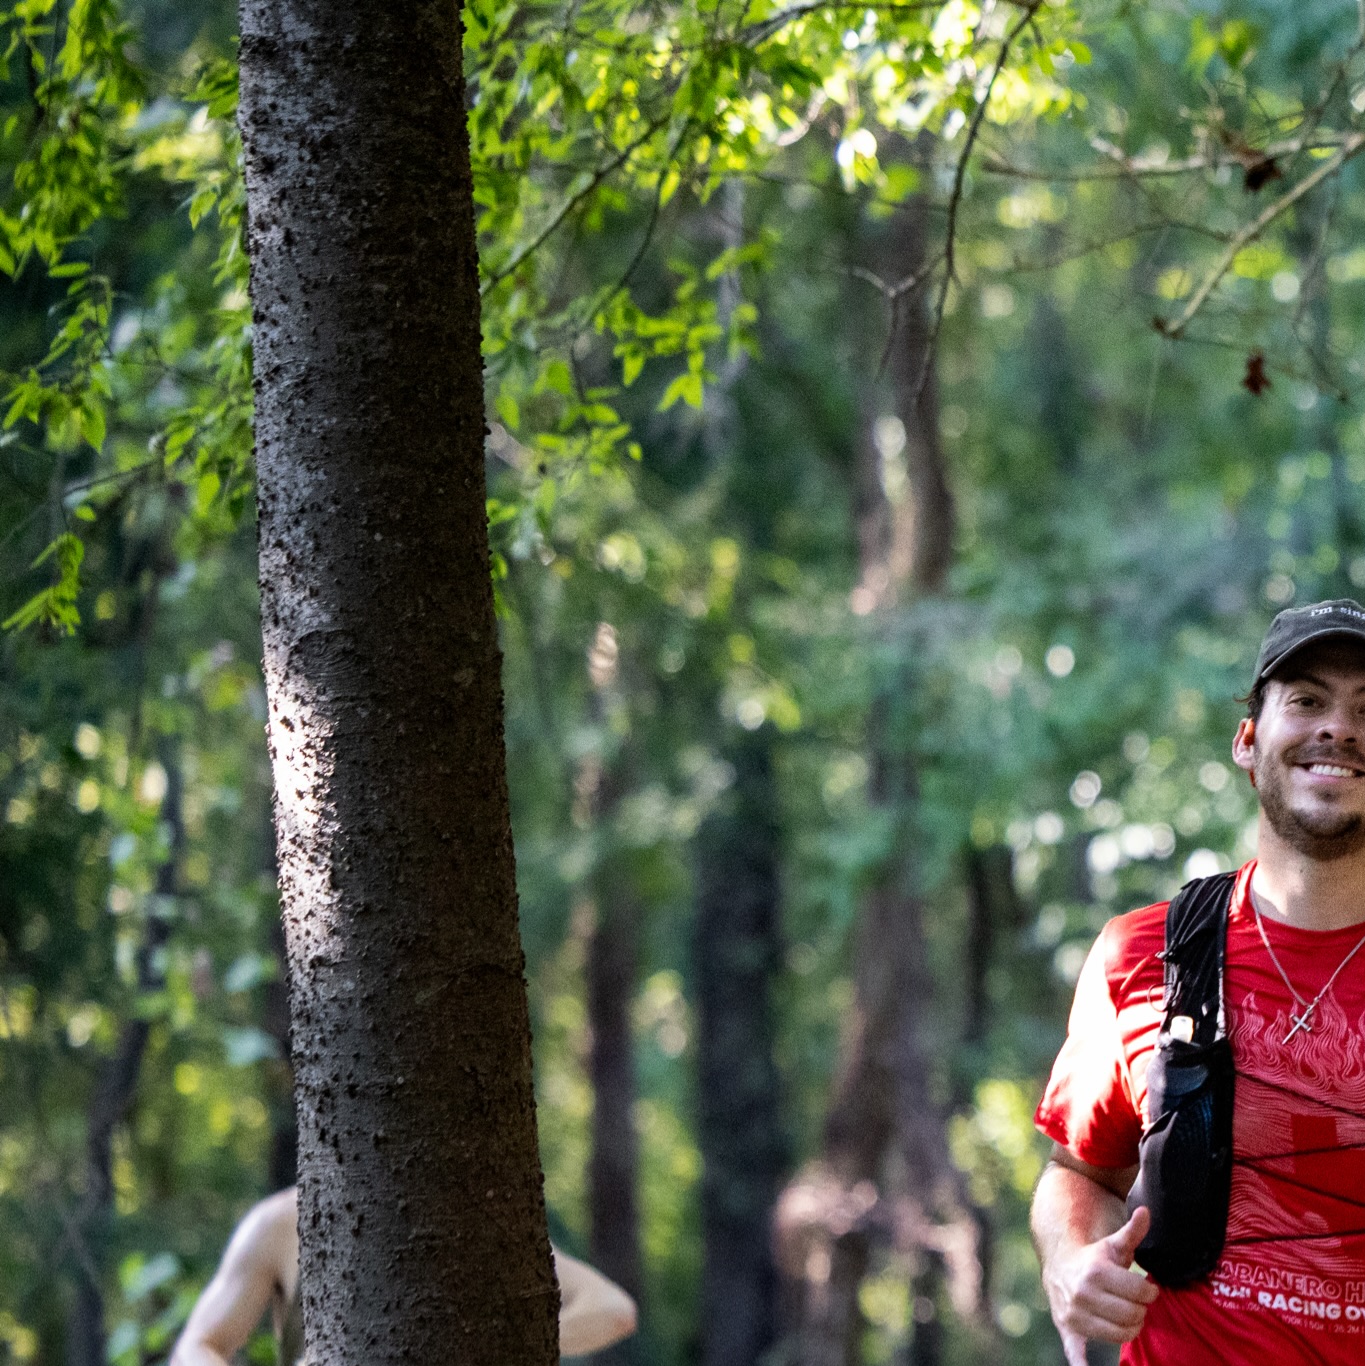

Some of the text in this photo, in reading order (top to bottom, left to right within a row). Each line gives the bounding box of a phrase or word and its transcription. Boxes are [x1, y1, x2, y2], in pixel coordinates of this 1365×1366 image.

[1310, 606, 1332, 617] i'm
[1210, 1260, 1342, 1300] ABANERO
[1257, 1290, 1342, 1320] RACING
